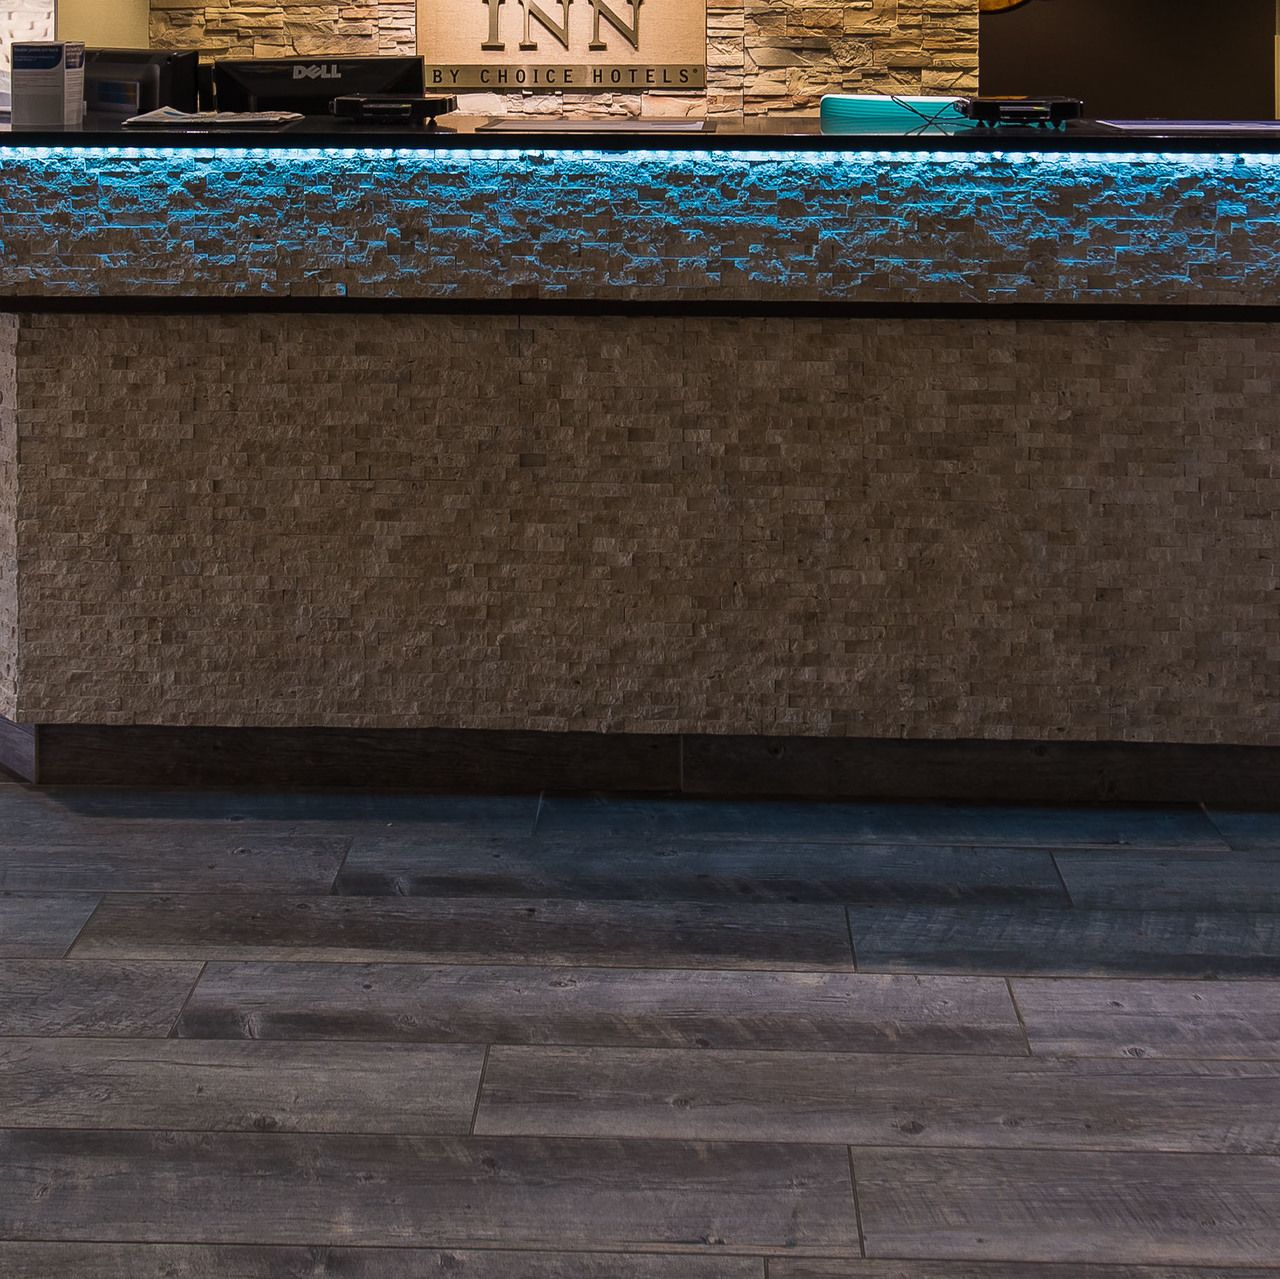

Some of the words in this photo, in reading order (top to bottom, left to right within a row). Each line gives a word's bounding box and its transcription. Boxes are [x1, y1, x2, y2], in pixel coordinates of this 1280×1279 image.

[292, 64, 342, 79] DELL
[432, 69, 460, 84] BY
[480, 69, 573, 84] CHOICE
[593, 69, 689, 84] HOTELS
